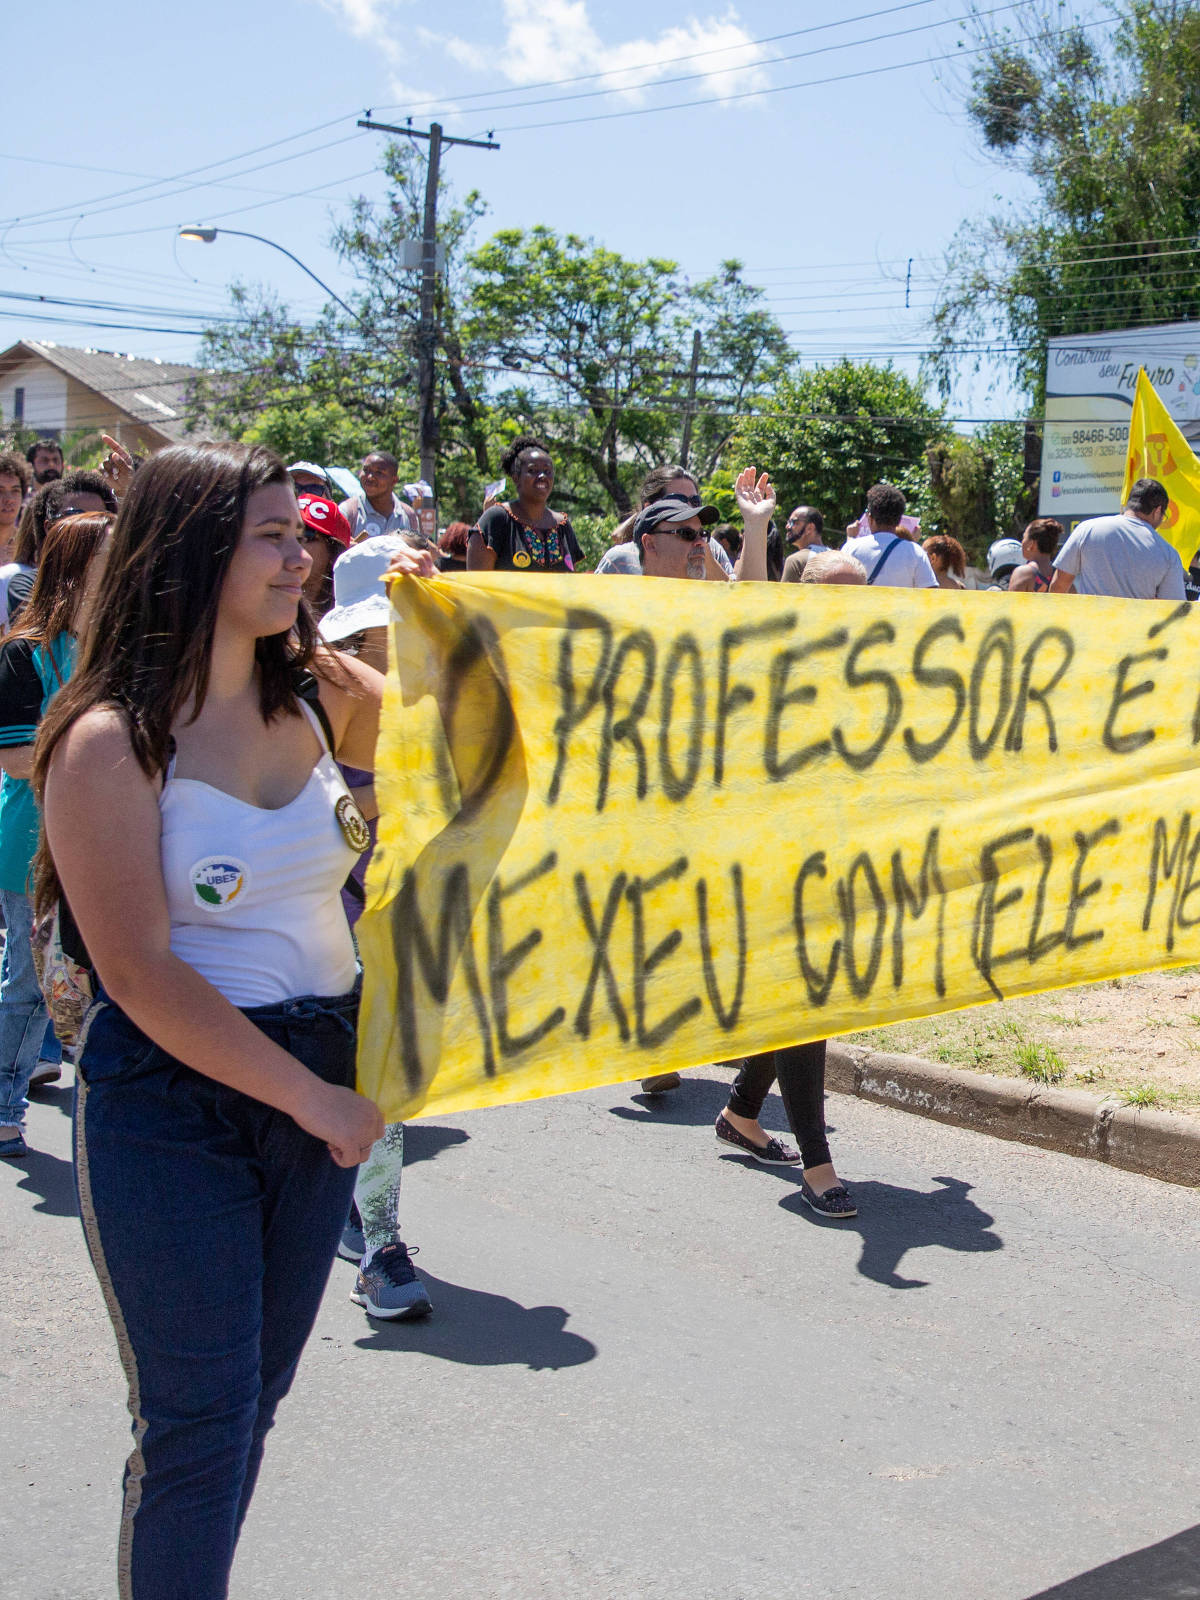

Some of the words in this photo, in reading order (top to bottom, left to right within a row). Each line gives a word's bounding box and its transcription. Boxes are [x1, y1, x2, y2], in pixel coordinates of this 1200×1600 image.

[1098, 364, 1120, 378] seu
[1117, 363, 1175, 389] Fuuro
[1072, 427, 1129, 444] 98466-500
[546, 607, 1075, 812] PROFESSOR
[1102, 602, 1194, 755] É
[206, 872, 237, 885] UBES
[391, 850, 748, 1100] MEXEU
[794, 826, 947, 1007] COM
[970, 817, 1121, 1001] ELE
